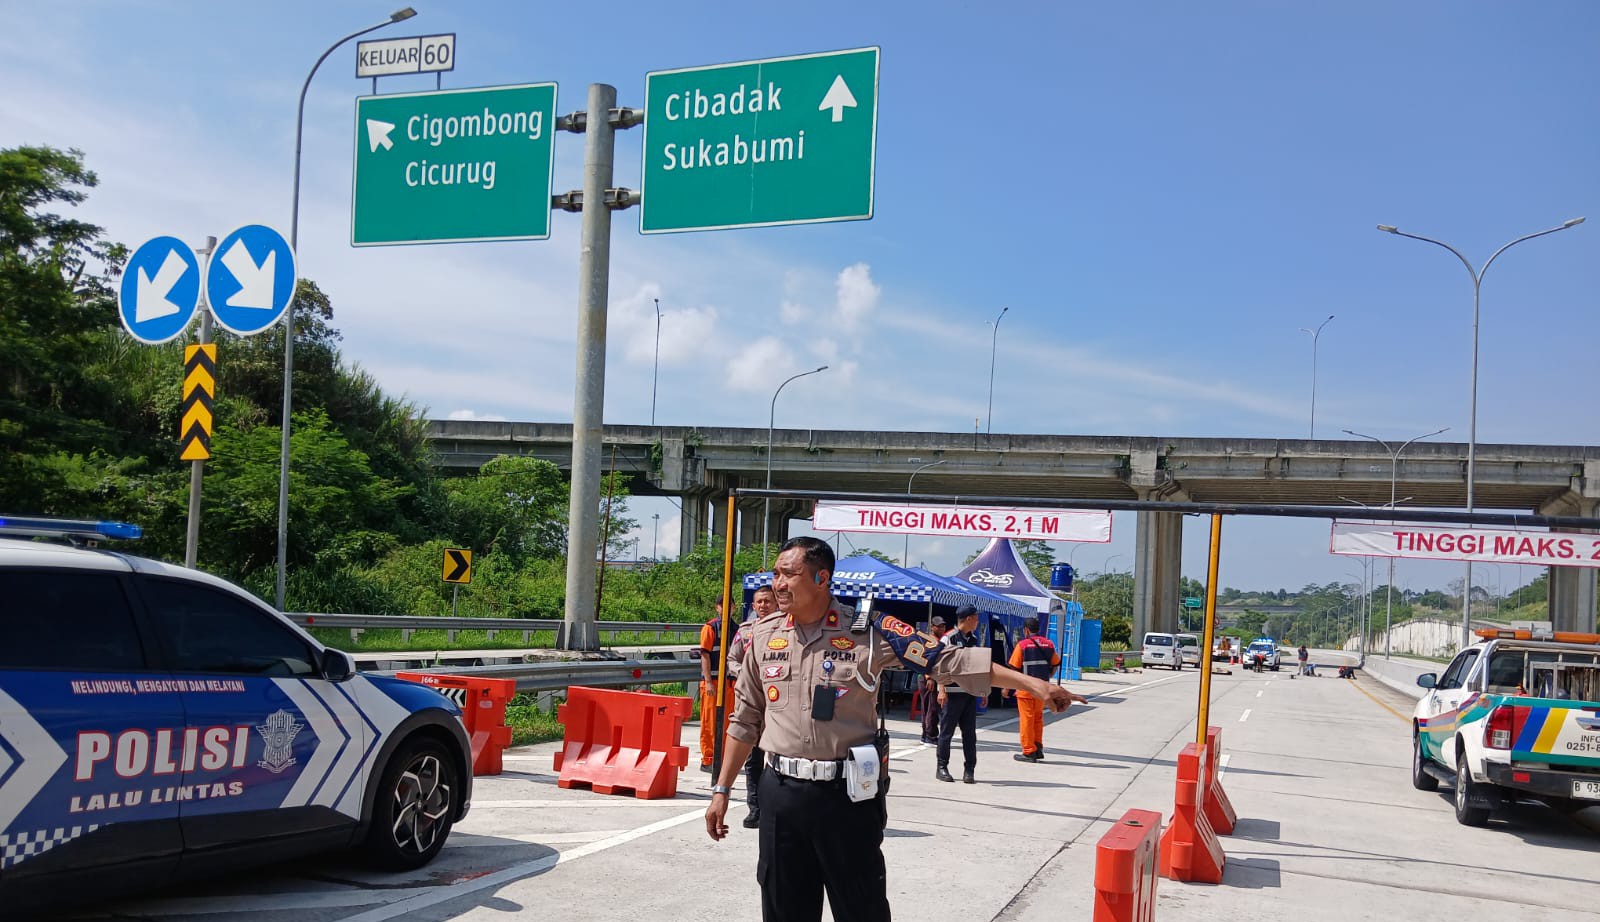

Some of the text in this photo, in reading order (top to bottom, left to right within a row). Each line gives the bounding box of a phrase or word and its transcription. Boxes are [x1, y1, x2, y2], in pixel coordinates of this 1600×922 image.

[359, 43, 450, 67] KELUAR 60
[665, 82, 782, 121] Cibadak
[407, 107, 543, 147] Cigombong
[663, 130, 805, 170] Sukabumi
[405, 160, 496, 190] Cicurug
[858, 510, 1059, 535] TINGGI MAKS. 2,1 M
[1393, 531, 1485, 554] TINGGI
[1493, 535, 1581, 559] MAKS.
[833, 571, 876, 580] OLISI
[823, 651, 856, 661] POLRI
[71, 680, 246, 695] MELINDUNGI, MENGAYOMI DAN MELAYANI
[75, 725, 249, 782] POLISI
[70, 781, 244, 813] LALU LINTAS
[1575, 782, 1600, 793] B 93
